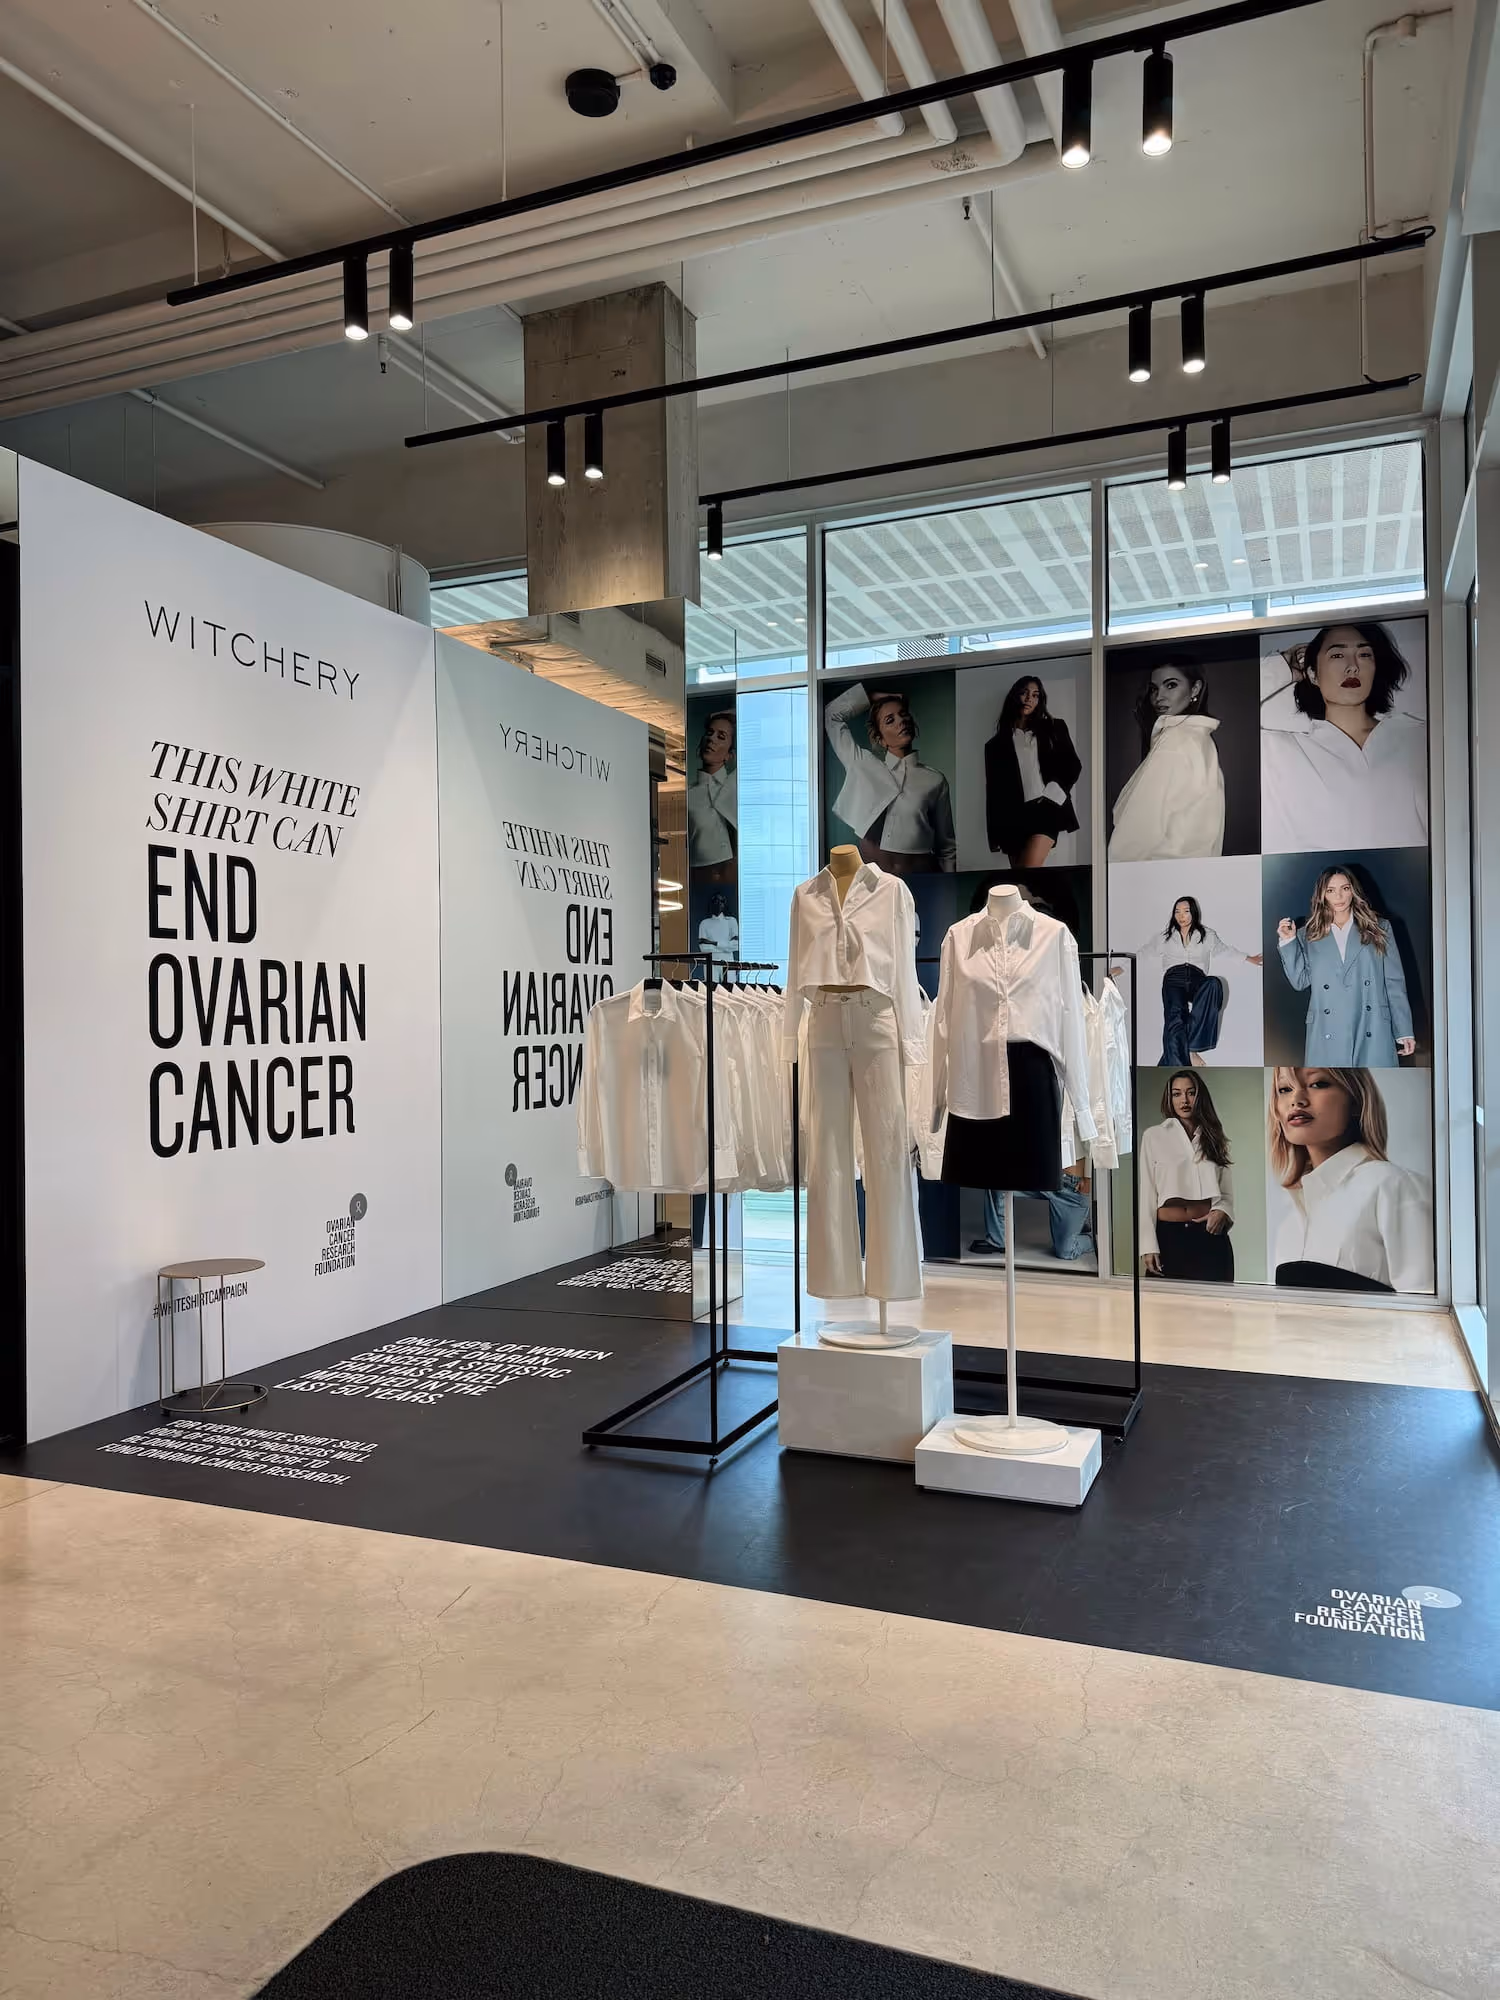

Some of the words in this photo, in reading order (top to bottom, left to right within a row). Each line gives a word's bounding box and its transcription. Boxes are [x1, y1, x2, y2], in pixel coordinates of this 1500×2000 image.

[144, 600, 360, 700] WITCHERY
[150, 740, 242, 794] THIS
[247, 763, 361, 818] WHITE
[145, 792, 269, 846] SHIRT
[272, 816, 344, 858] CAN
[147, 843, 258, 944] END
[148, 952, 367, 1049] OVARIAN
[149, 1055, 356, 1158] CANCER
[326, 1215, 356, 1233] OVARIAN
[329, 1228, 356, 1246] CANCER
[321, 1241, 356, 1261] RESEARCH
[314, 1254, 356, 1276] FOUNDATION
[374, 1345, 467, 1357] SURVIVE
[462, 1352, 558, 1365] OVARIAN
[397, 1337, 455, 1346] ONLY
[451, 1342, 500, 1350] 49%
[527, 1347, 613, 1360] WOMEN
[329, 1361, 389, 1373] THAT
[380, 1365, 433, 1377] HAS
[427, 1370, 519, 1385] BARELY
[438, 1360, 461, 1368] A
[459, 1362, 571, 1378] STATISTIC
[273, 1379, 340, 1392] LAST
[330, 1385, 369, 1396] 50
[365, 1388, 444, 1404] YEARS.
[300, 1370, 418, 1387] IMPROVED
[413, 1380, 448, 1390] IN
[444, 1383, 496, 1395] THE
[166, 1420, 201, 1429] FOR
[195, 1423, 248, 1435] EVERY
[240, 1429, 293, 1440] WHITE
[287, 1435, 339, 1446] SHIRT
[97, 1444, 144, 1455] FUND
[137, 1449, 208, 1464] OVARIAN
[201, 1458, 267, 1473] CANCER
[121, 1435, 150, 1444] BE
[141, 1438, 213, 1453] DONATED
[208, 1447, 235, 1455] TO
[230, 1450, 267, 1460] THE
[260, 1454, 308, 1466] OCRF
[303, 1459, 330, 1469] TO
[182, 1432, 210, 1441] OF
[202, 1435, 256, 1447] GROSS
[251, 1441, 334, 1458] PROCEEDS
[330, 1450, 370, 1462] WILL
[1331, 1589, 1420, 1610] OVARIAN
[1340, 1600, 1421, 1620] CANCER
[1295, 1613, 1425, 1641] FOUNDATION
[1317, 1606, 1423, 1631] RESEARCH
